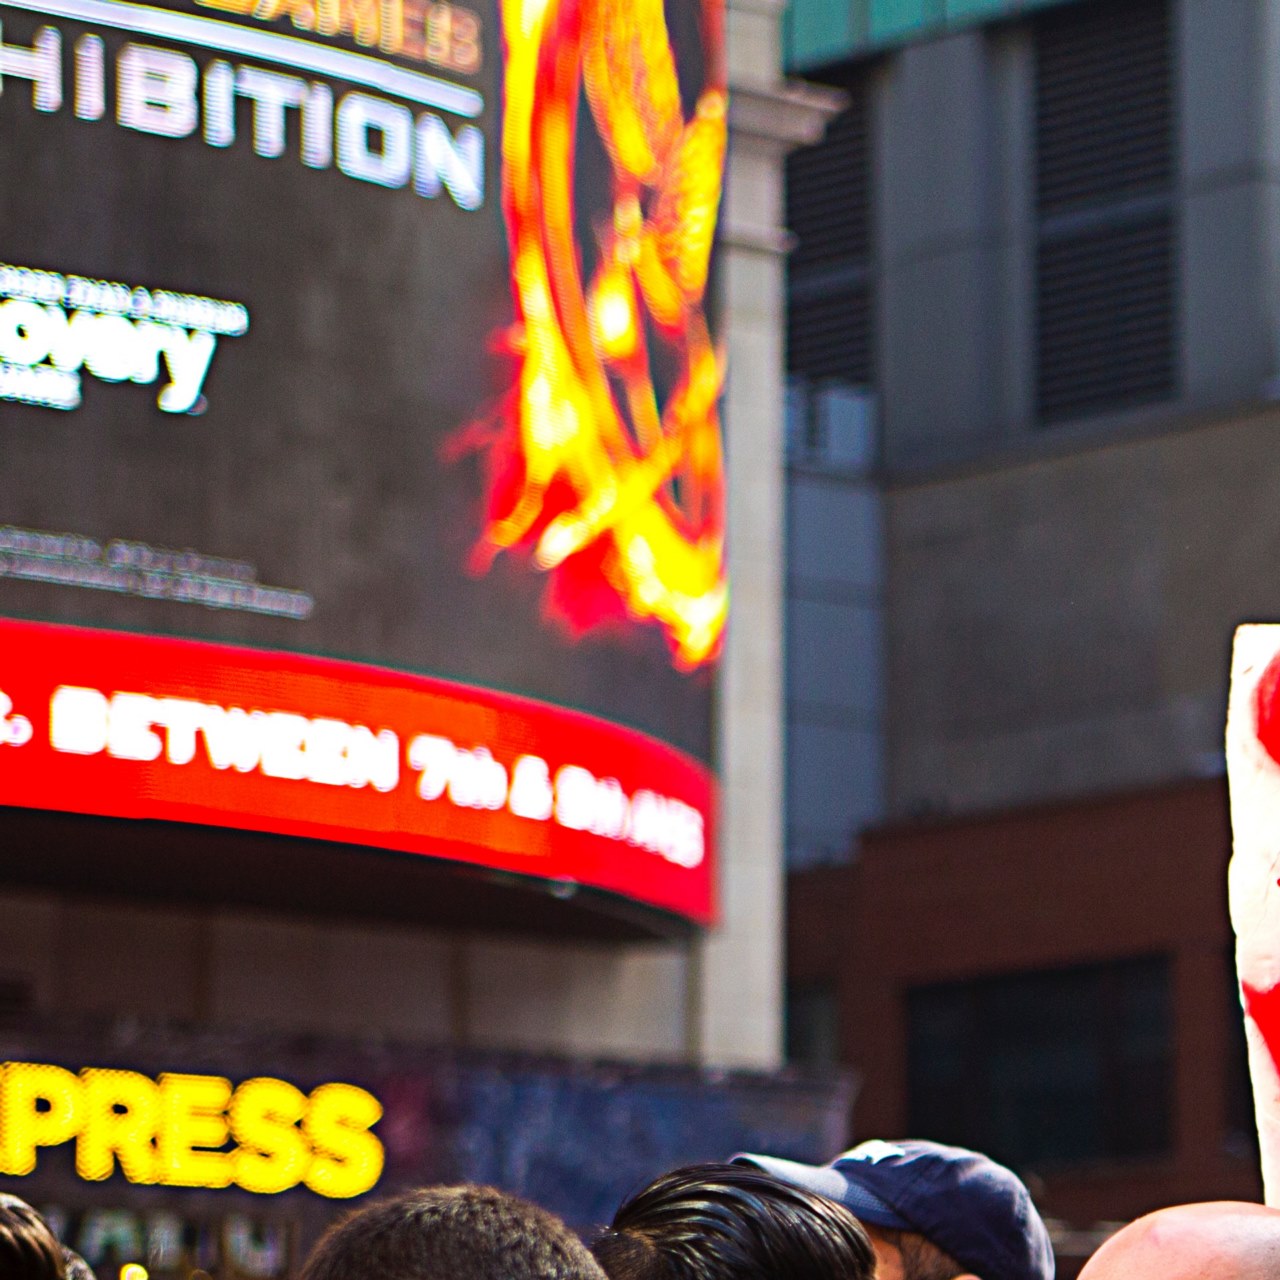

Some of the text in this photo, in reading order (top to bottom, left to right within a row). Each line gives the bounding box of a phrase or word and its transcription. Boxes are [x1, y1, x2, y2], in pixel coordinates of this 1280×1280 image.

[0, 18, 486, 211] HIBITION
[49, 684, 399, 793] BETWEEN
[0, 1061, 384, 1198] PRESS
